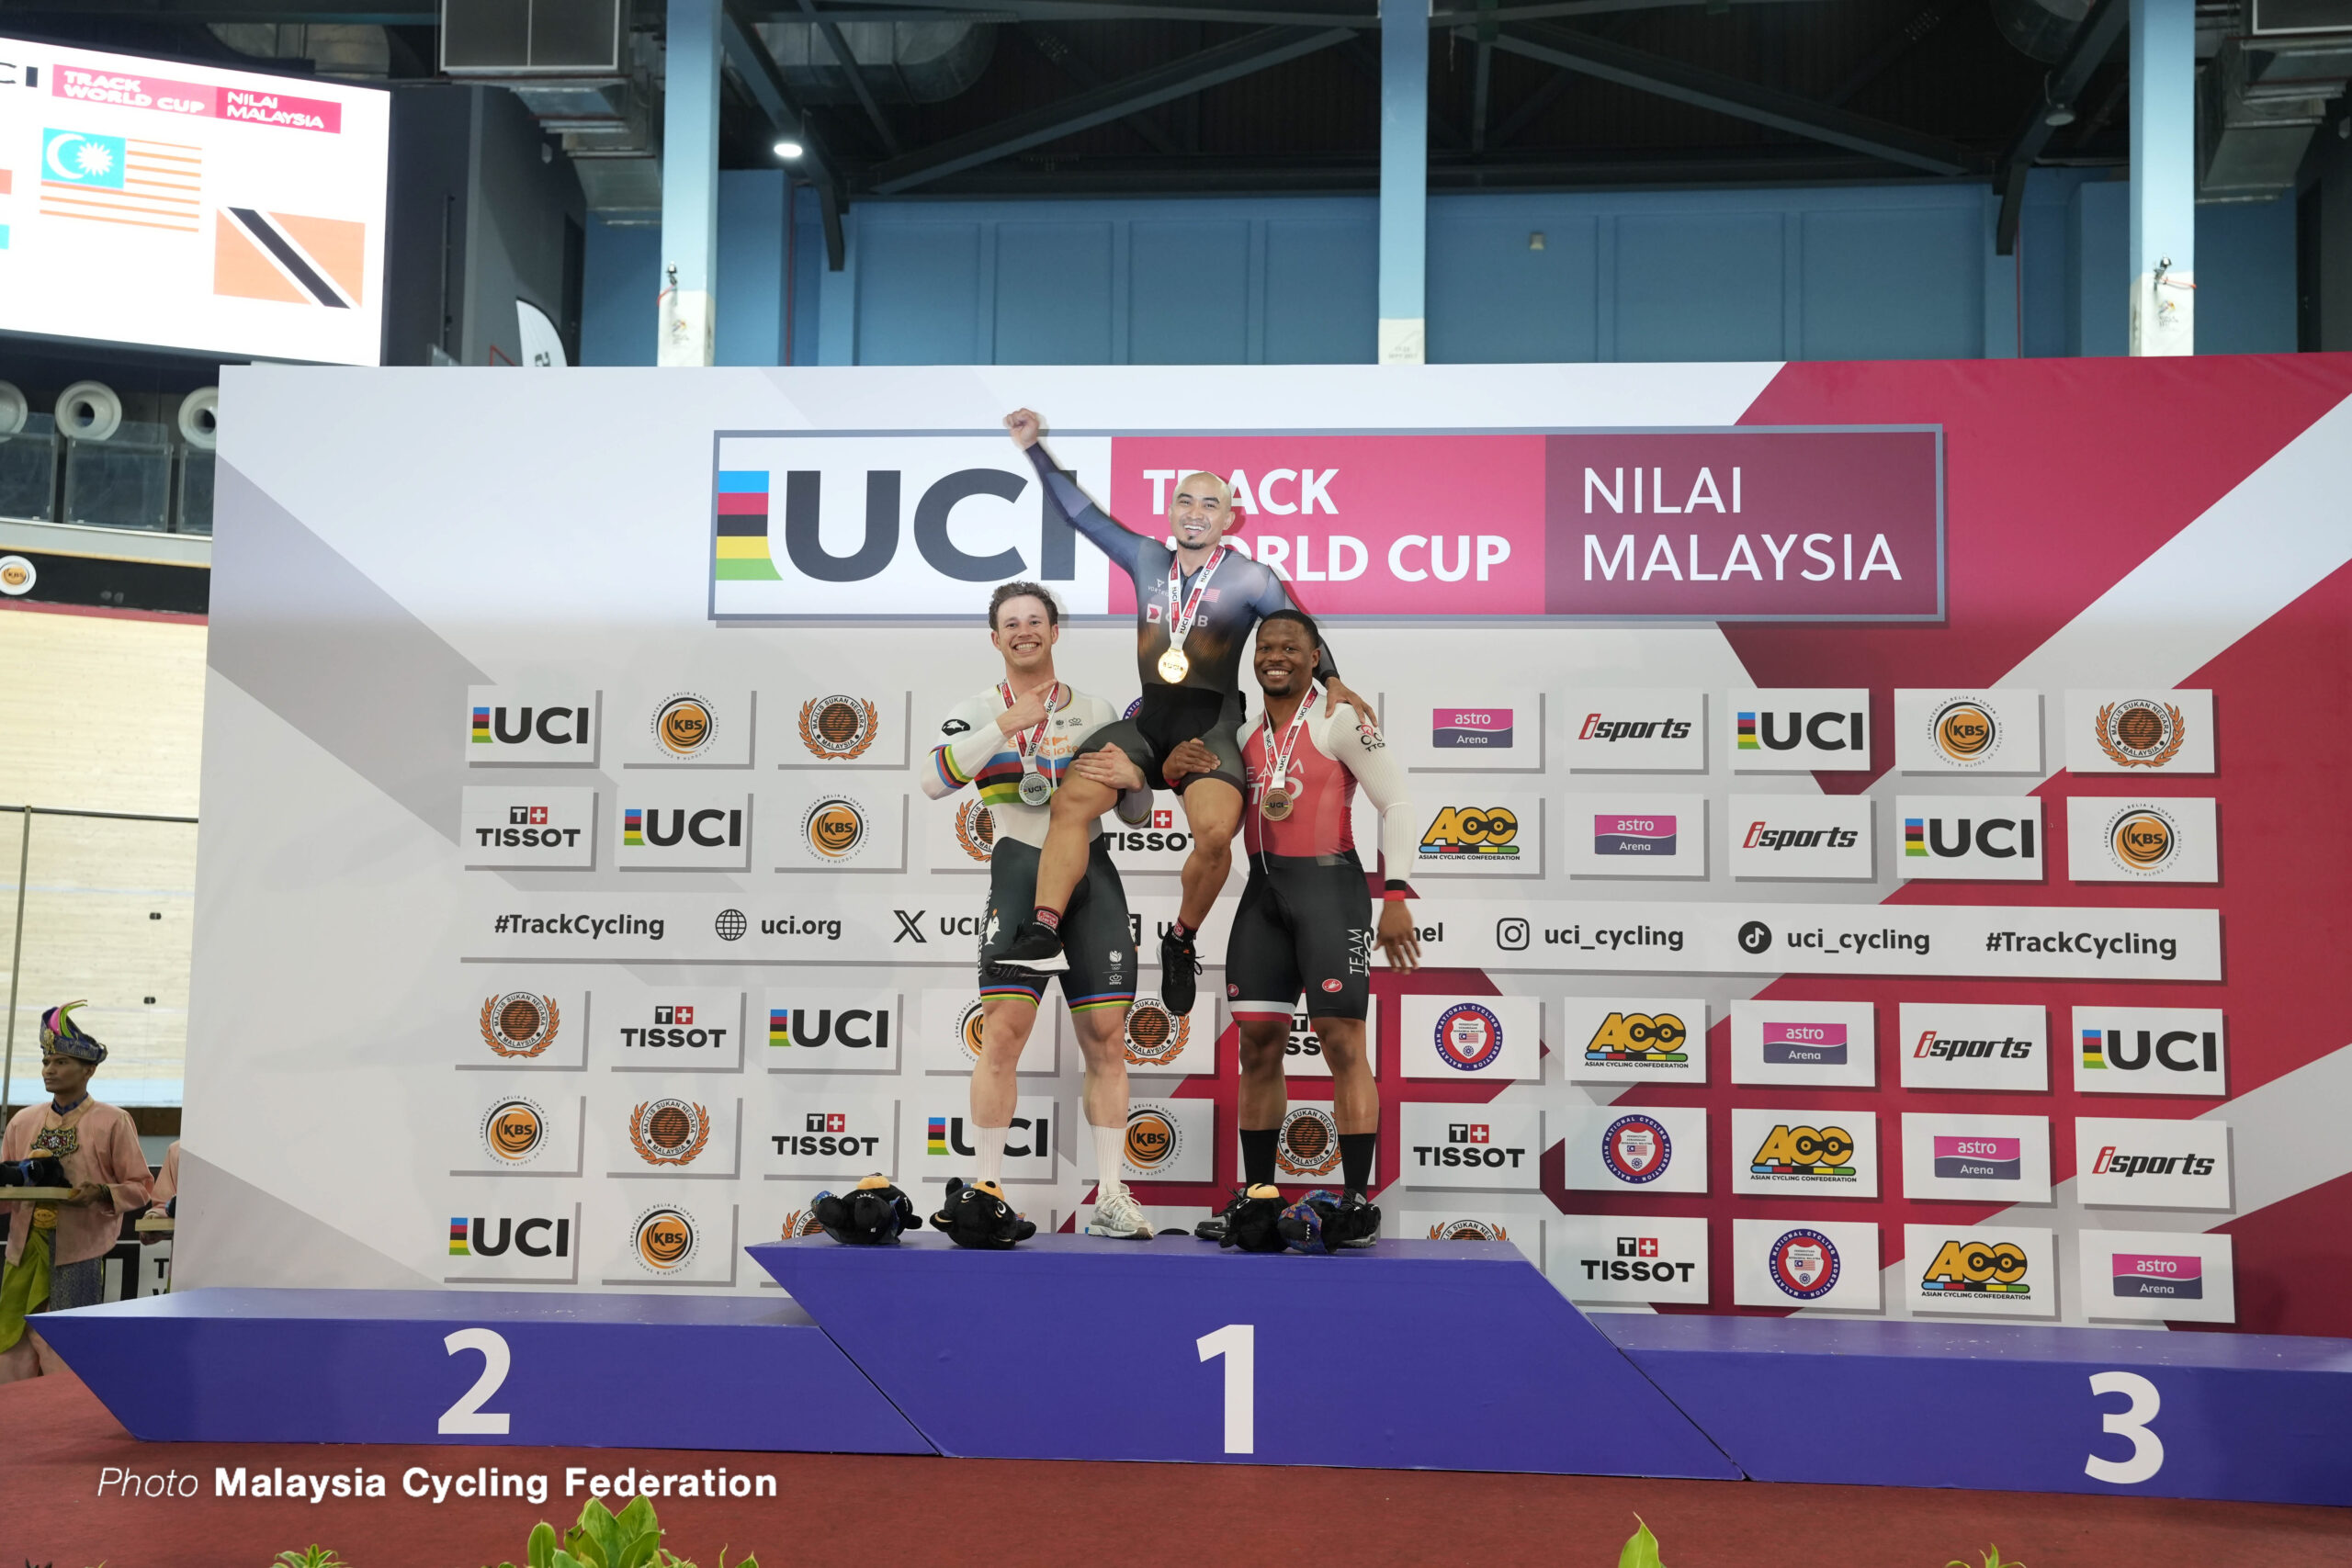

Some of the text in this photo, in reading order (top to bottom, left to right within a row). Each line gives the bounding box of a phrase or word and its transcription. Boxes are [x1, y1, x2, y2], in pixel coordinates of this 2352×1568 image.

[63, 71, 141, 92] TRACK
[63, 84, 205, 113] WORLD CUP
[227, 92, 278, 109] NILAI
[227, 104, 324, 129] MALAYSIA
[1143, 468, 1340, 515] TACK
[1584, 467, 1741, 514] NILAI
[786, 468, 1077, 582] UCI
[1387, 534, 1511, 582] CUP
[1584, 533, 1903, 581] MALAYSIA
[812, 697, 864, 729] MAJLIS SUKAN NEGARA
[1454, 712, 1491, 725] astro
[2111, 701, 2169, 736] MAJLIS SUKAN NEGARA
[494, 706, 589, 745] UCI
[674, 719, 703, 733] KBS
[1761, 712, 1864, 751] UCI
[1953, 725, 1984, 739] KBS
[821, 739, 855, 749] MALAYSIA
[1456, 735, 1488, 744] Arena
[2122, 746, 2160, 756] MALAYSIA
[1028, 785, 1043, 794] UCI
[646, 808, 742, 847] UCI
[824, 822, 854, 836] KBS
[969, 806, 981, 831] MAJLIS
[1617, 818, 1655, 831] astro
[475, 828, 582, 848] TISSOT
[1102, 831, 1193, 852] TISSO
[1619, 841, 1651, 851] Arena
[1929, 818, 2035, 859] UCI
[2131, 833, 2164, 847] KBS
[494, 913, 664, 941] #TrackCycling
[761, 915, 842, 941] uci.org
[1544, 924, 1684, 952] uci_cycling
[1787, 928, 1930, 955] uci_cycling
[1985, 931, 2177, 961] #TrackCycling
[1347, 929, 1364, 975] TEAM
[493, 994, 546, 1027] MAJLIS SUKAN NEGARA
[1135, 1000, 1160, 1010] SUKAN
[1437, 1005, 1467, 1030] NATIONAL
[1471, 1005, 1498, 1028] CYCLING
[620, 1028, 727, 1048] TISSOT
[793, 1009, 889, 1048] UCI
[1786, 1027, 1825, 1040] astro
[502, 1037, 537, 1047] MALAYSIA
[1132, 1043, 1167, 1055] MALAYSIA
[2107, 1030, 2217, 1072] UCI
[1788, 1050, 1821, 1060] Arena
[643, 1101, 695, 1134] MAJLIS SUKAN NEGARA
[1281, 1110, 1334, 1144] MAJLIS SUKAN NEGARA
[503, 1124, 533, 1138] KBS
[1605, 1116, 1635, 1142] NATIONAL
[1639, 1116, 1668, 1140] CYCLING
[651, 1144, 686, 1155] MALAYSIA
[771, 1135, 879, 1156] TISSOT
[1136, 1133, 1166, 1147] KBS
[1957, 1139, 1996, 1155] astro
[1289, 1154, 1326, 1165] MALAYSIA
[1413, 1146, 1525, 1168] TISSOT
[1960, 1164, 1994, 1175] Arena
[797, 1216, 808, 1236] AJLIS
[1453, 1222, 1479, 1232] SUKAN
[472, 1217, 570, 1258] UCI
[654, 1233, 684, 1247] KBS
[1772, 1231, 1803, 1257] NATIONAL
[1806, 1231, 1836, 1255] CYCLING
[1580, 1259, 1695, 1283] TISSOT
[2136, 1258, 2177, 1273] astro
[1973, 1292, 2031, 1301] CONFEDERATION
[2140, 1283, 2175, 1294] Arena
[437, 1327, 511, 1435] 2
[1195, 1324, 1254, 1454] 1
[2084, 1371, 2165, 1484] 3
